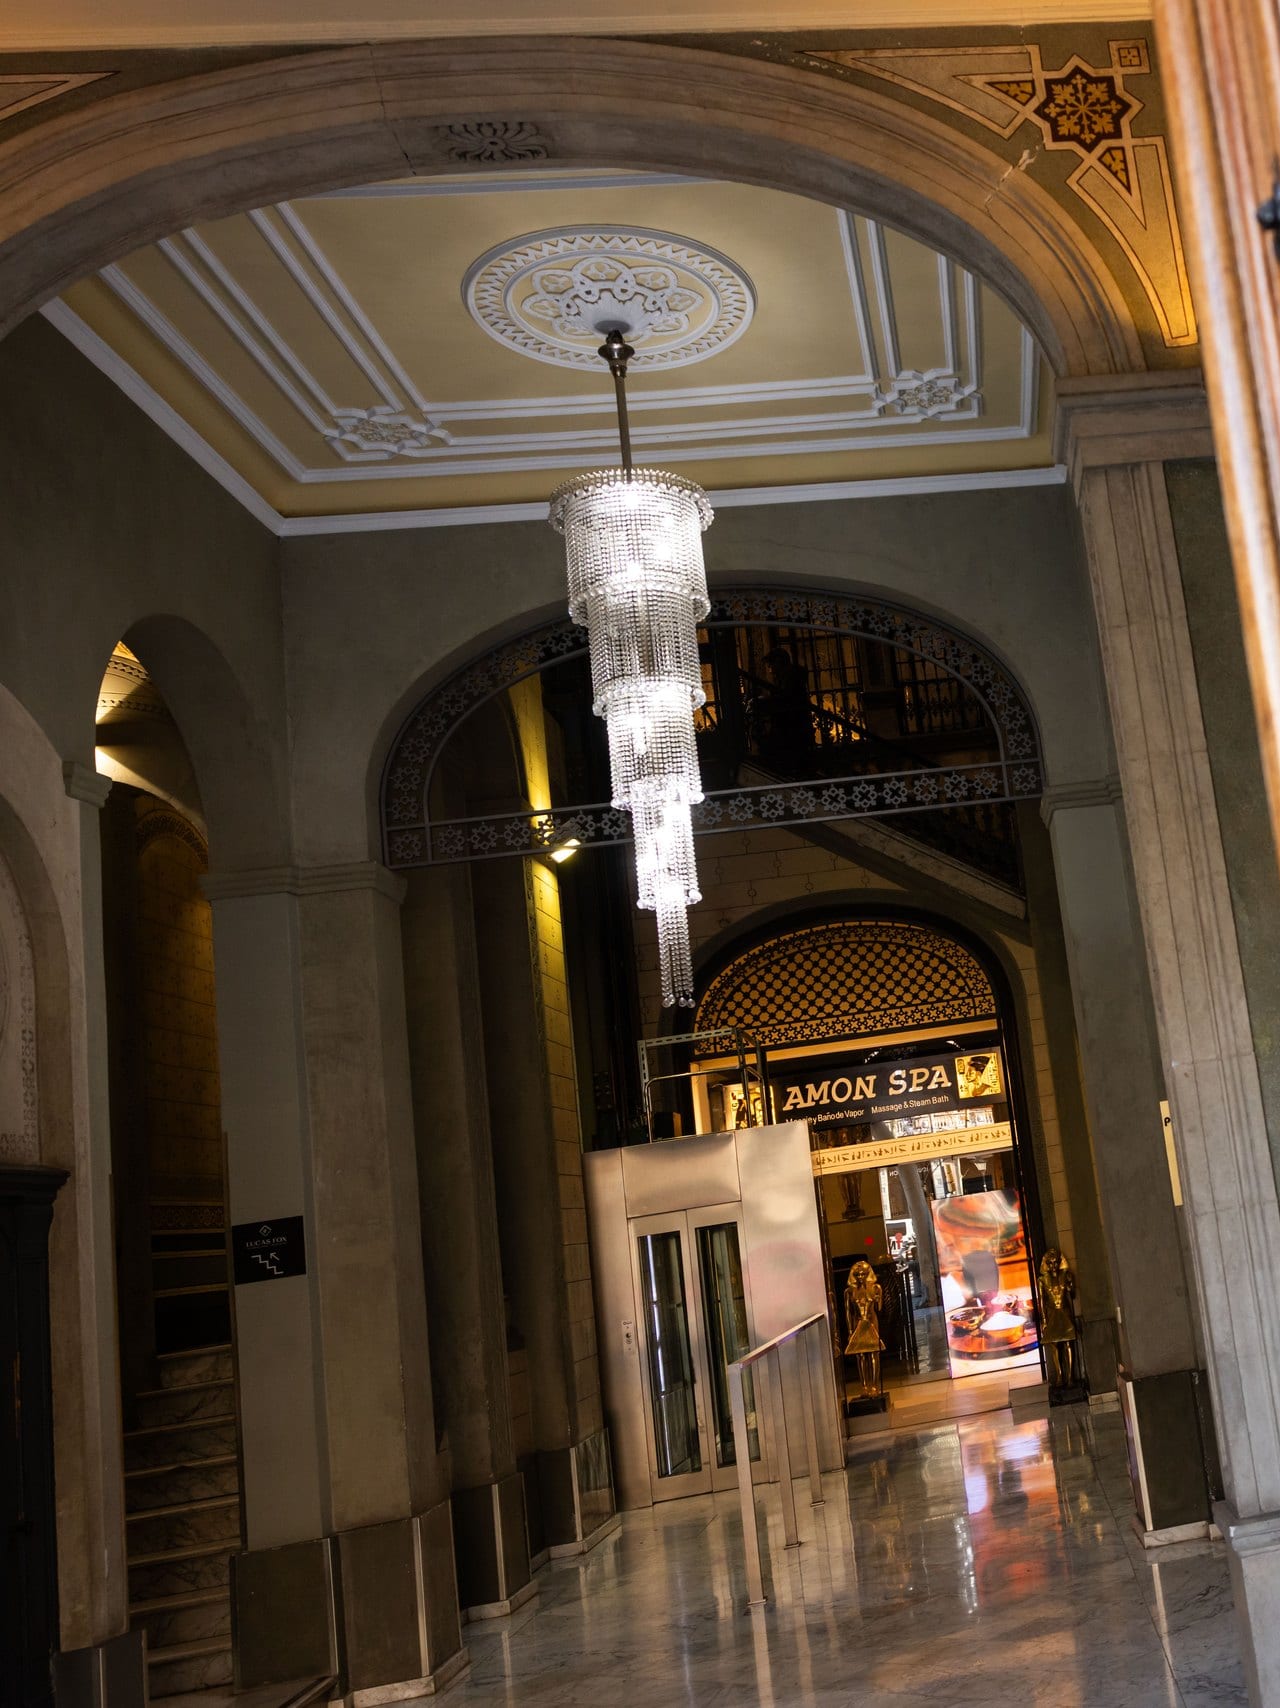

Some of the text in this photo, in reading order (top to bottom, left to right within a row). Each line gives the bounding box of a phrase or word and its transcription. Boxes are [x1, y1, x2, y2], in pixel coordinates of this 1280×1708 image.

[782, 1065, 952, 1111] AMON SPA
[871, 1095, 949, 1114] Massage & Steam Bath
[818, 1111, 836, 1122] Baño
[836, 1111, 844, 1119] de
[844, 1109, 865, 1118] Vapor
[246, 1239, 271, 1247] LUCAS
